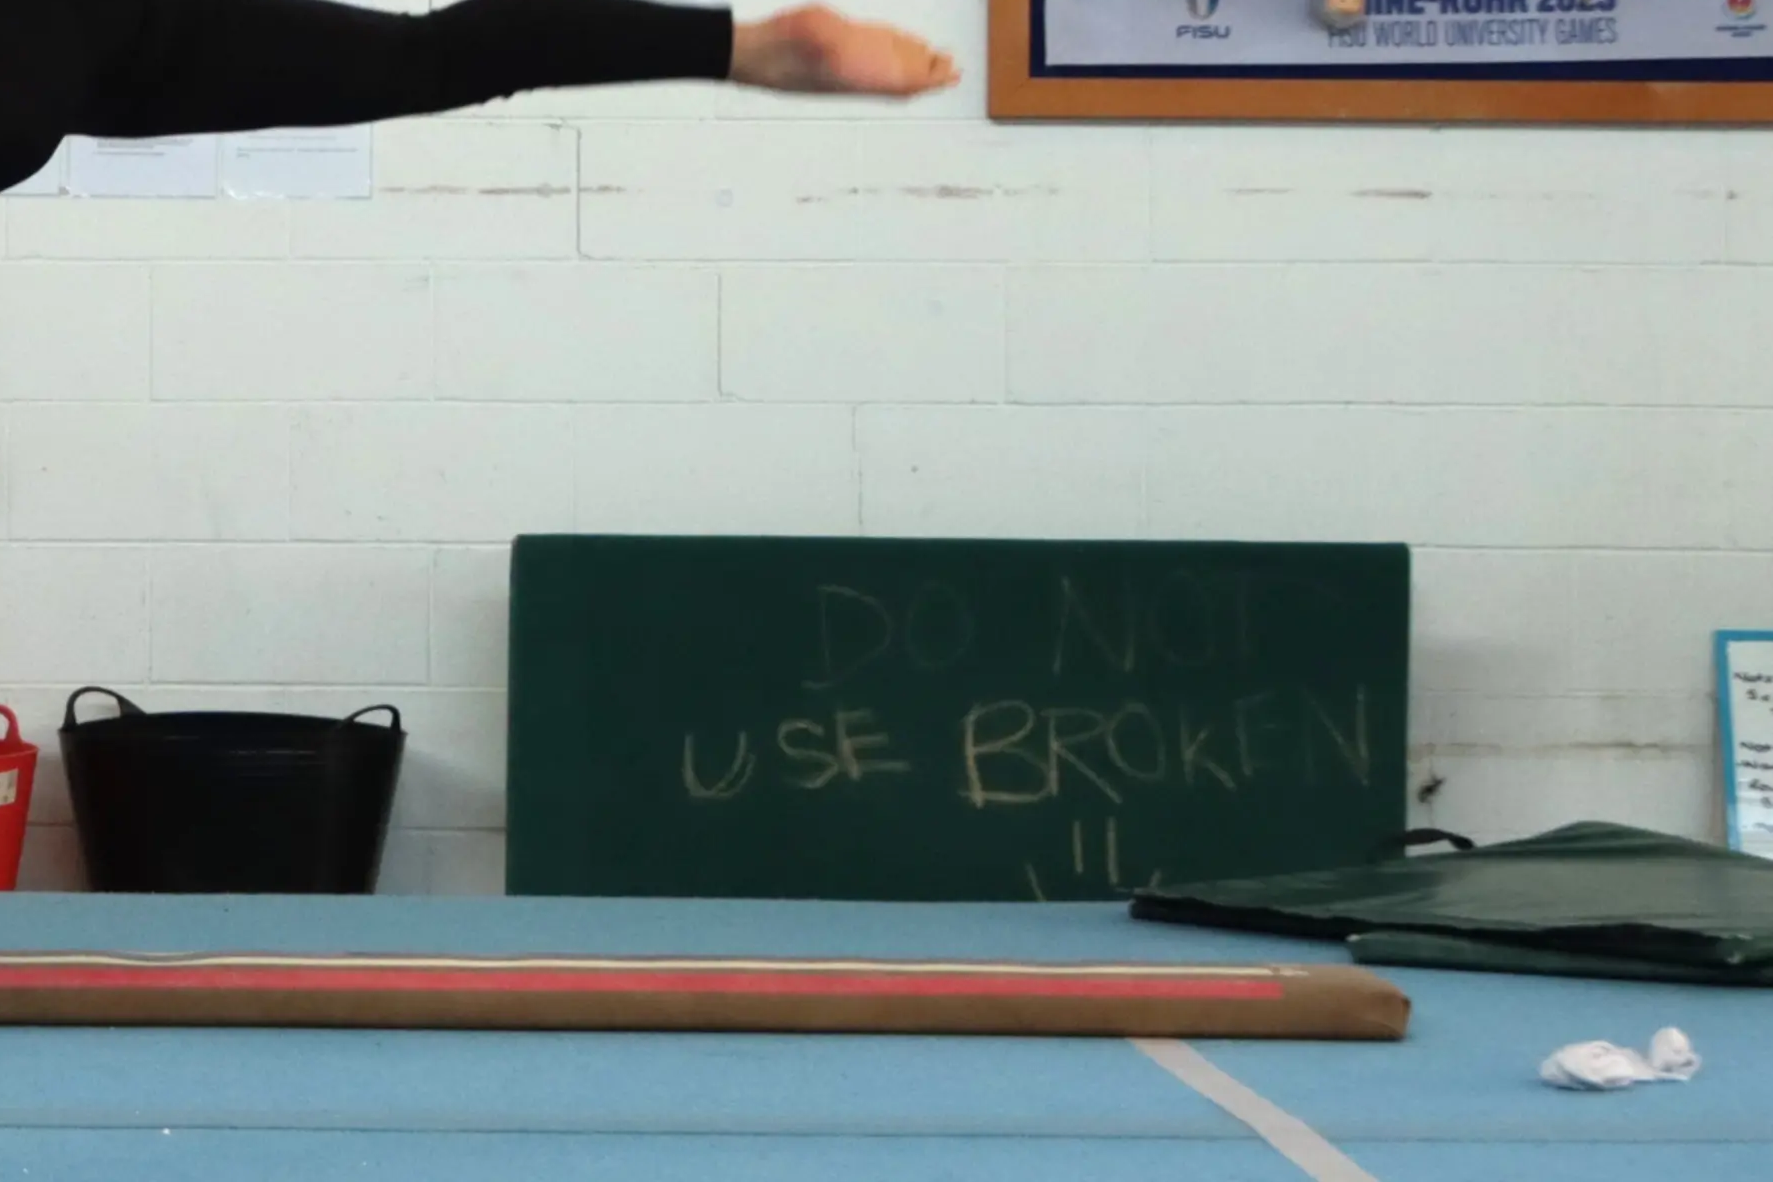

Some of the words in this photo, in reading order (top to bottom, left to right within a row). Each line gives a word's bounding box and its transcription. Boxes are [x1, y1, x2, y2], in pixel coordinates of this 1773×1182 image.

[1175, 25, 1231, 39] FISU
[1373, 20, 1437, 48] WORLD
[1445, 19, 1549, 46] UNIVERSITY
[1555, 18, 1618, 45] GAMES
[801, 580, 978, 690] DO
[681, 704, 913, 801] USE
[958, 684, 1371, 809] BROKEN
